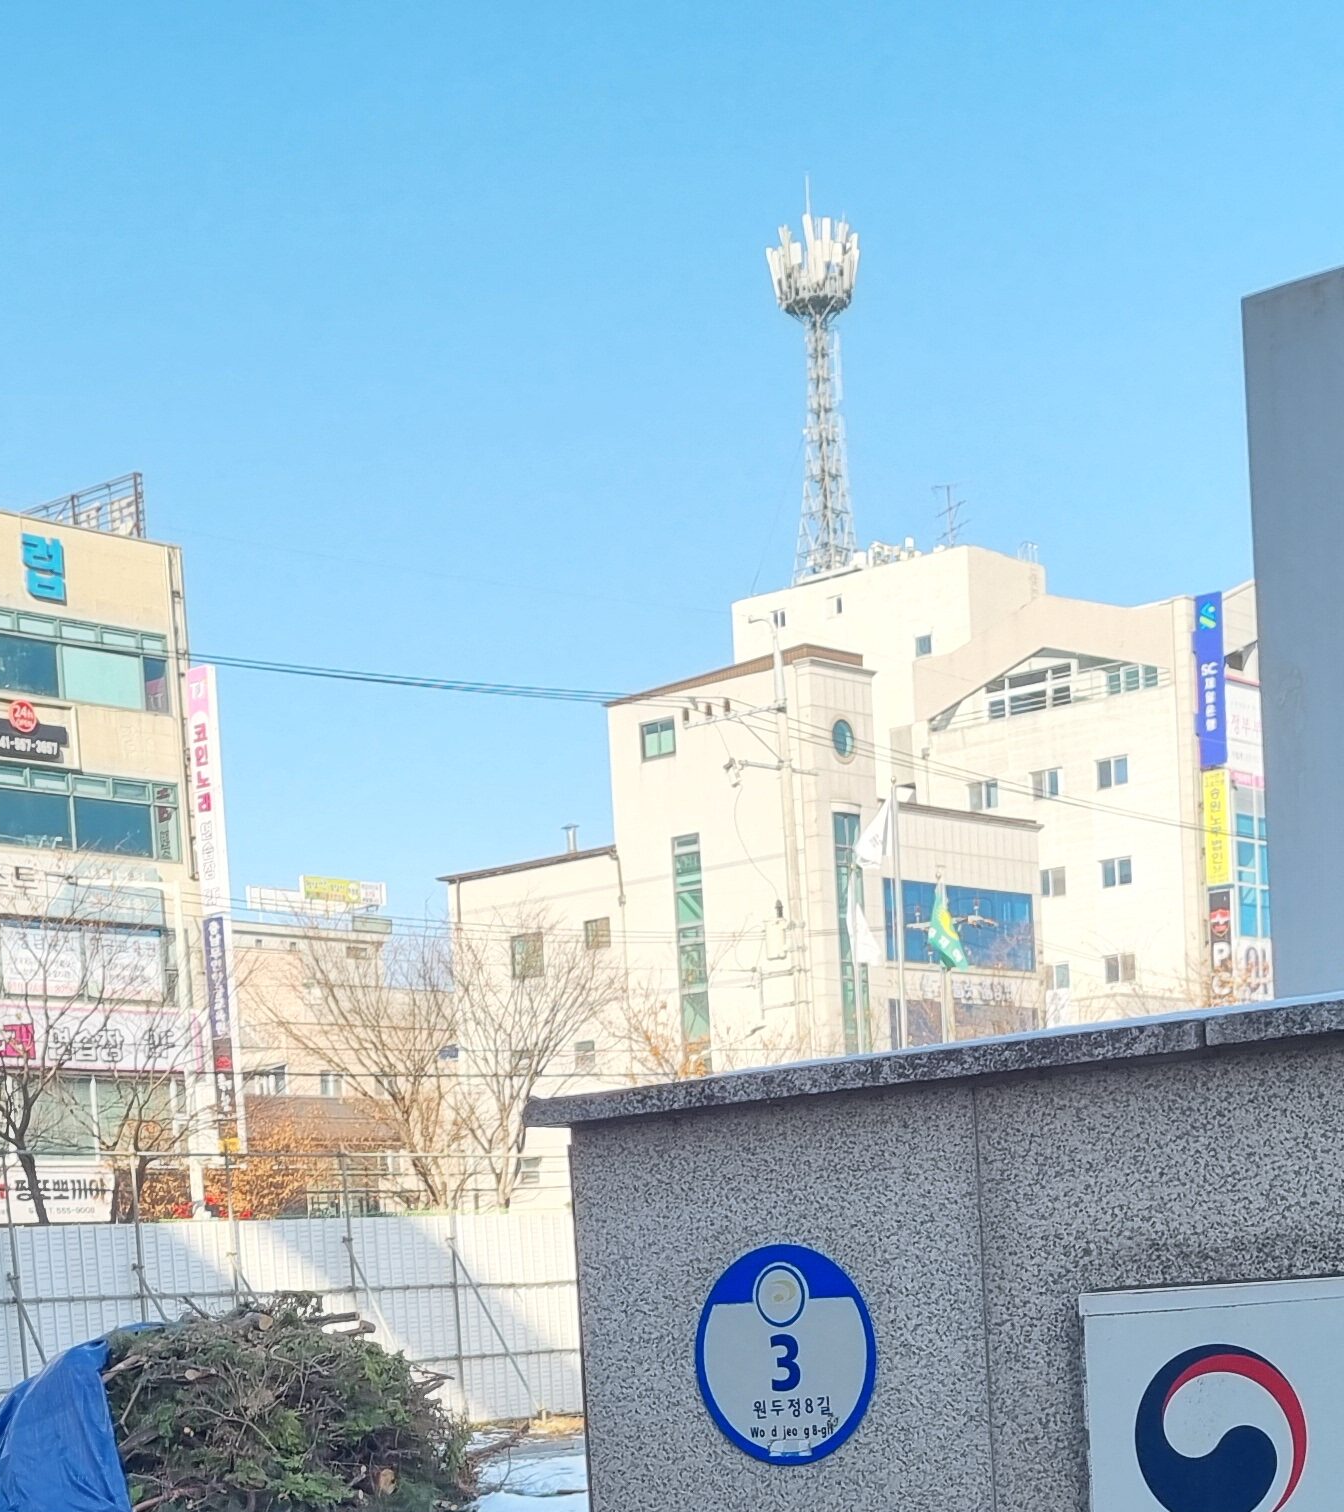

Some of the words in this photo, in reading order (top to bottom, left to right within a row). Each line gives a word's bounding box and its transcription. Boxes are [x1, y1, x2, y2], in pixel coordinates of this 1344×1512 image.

[193, 723, 212, 813] 코인노래
[769, 1333, 802, 1392] 3
[752, 1395, 831, 1419] 원두정8길
